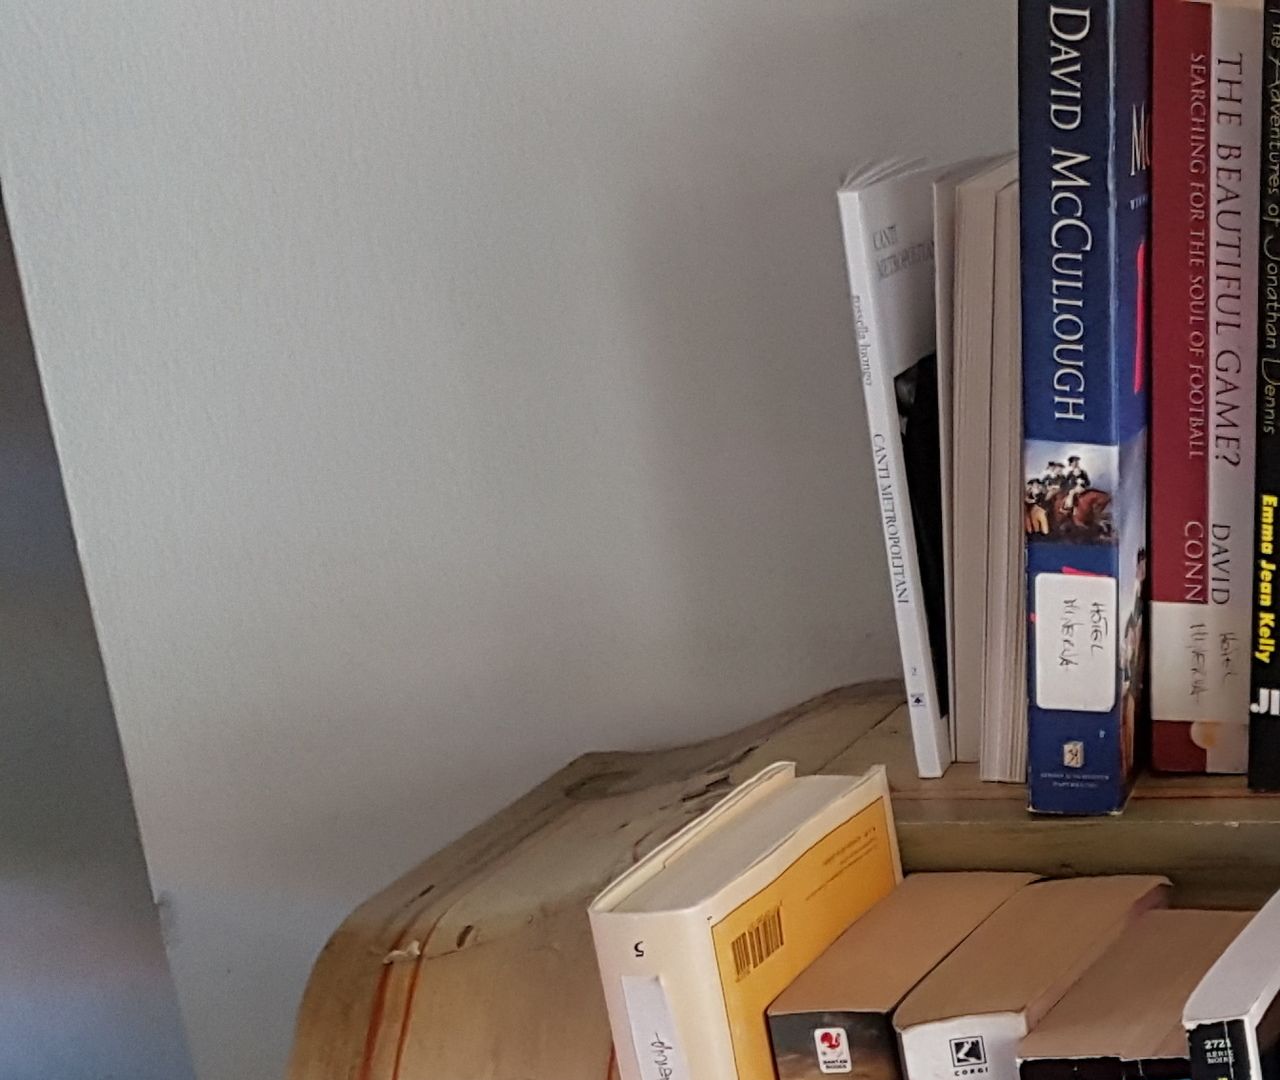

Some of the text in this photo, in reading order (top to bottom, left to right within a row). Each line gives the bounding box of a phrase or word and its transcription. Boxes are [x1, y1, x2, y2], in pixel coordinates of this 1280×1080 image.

[1049, 5, 1091, 130] DAVID
[1188, 53, 1206, 459] SEARCHING FOR THE SOUL OF FOOTBALL
[1215, 52, 1242, 468] THE BEAUTIFUL GAME?
[873, 433, 909, 604] CANTI METROPOLITANI
[1184, 521, 1203, 602] CONN
[1211, 523, 1231, 605] DAVID
[1256, 494, 1278, 664] Emma Jean Kelly
[954, 1067, 989, 1076] CORGI
